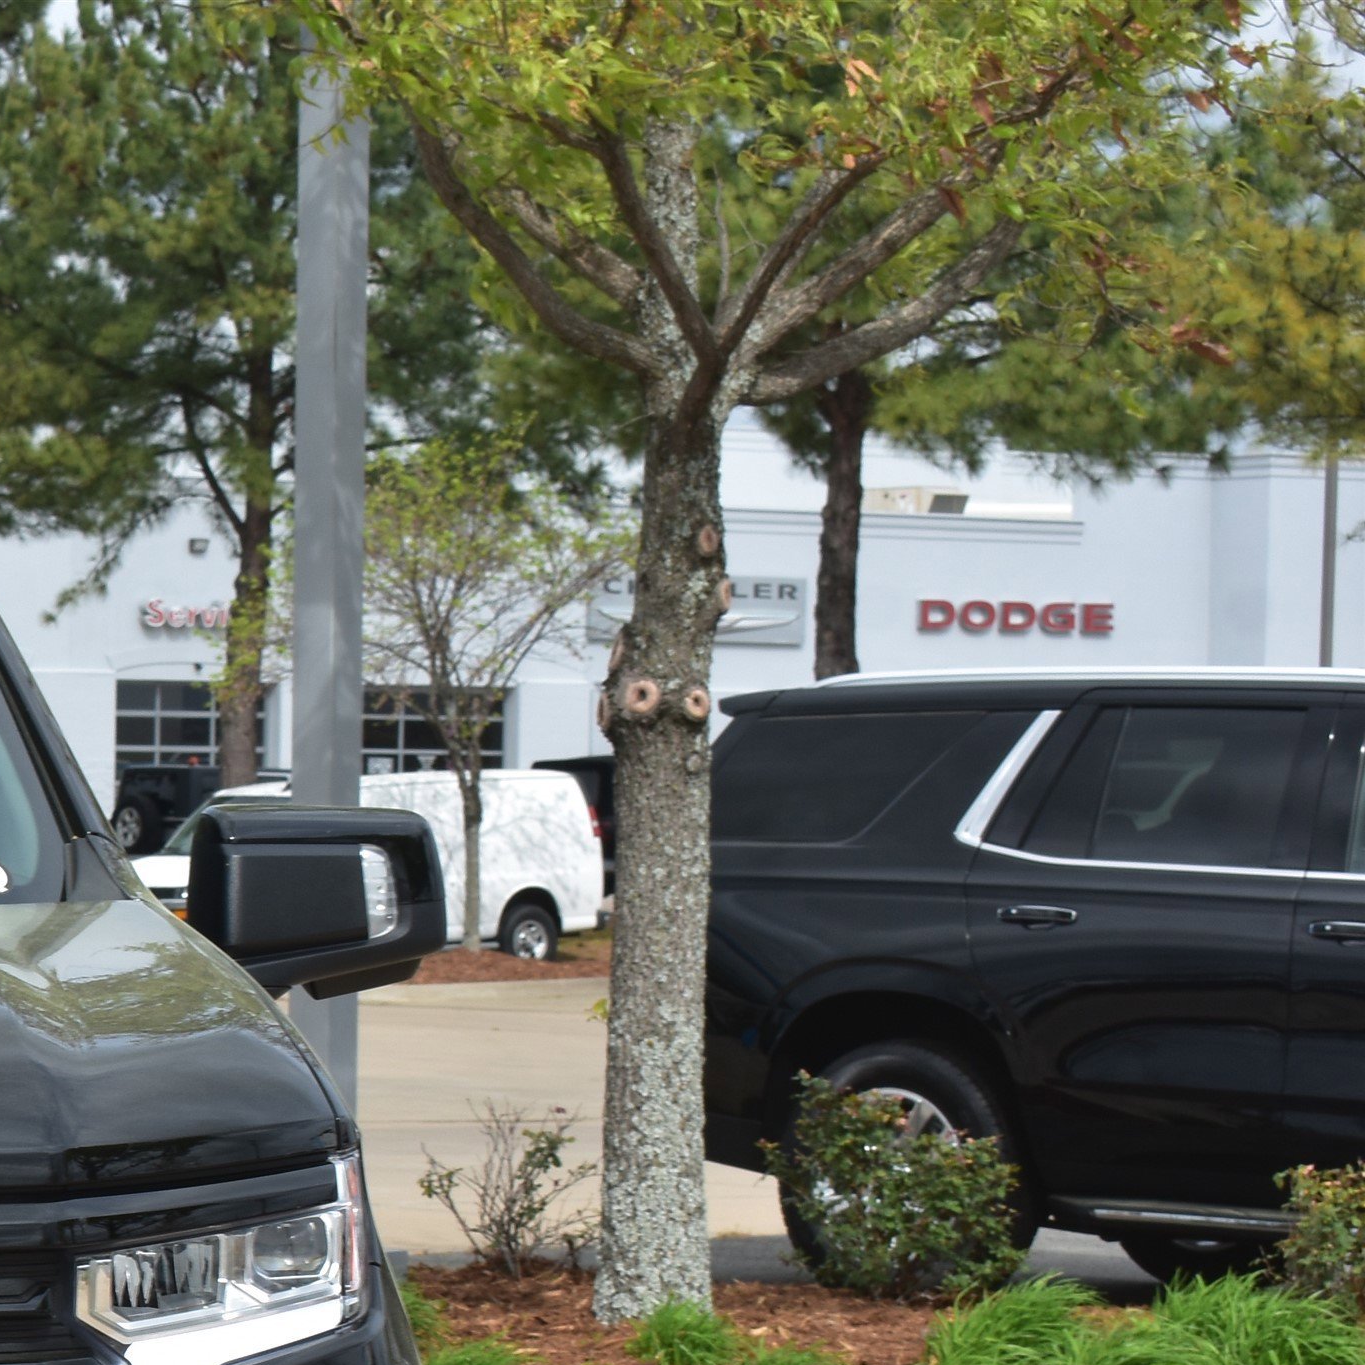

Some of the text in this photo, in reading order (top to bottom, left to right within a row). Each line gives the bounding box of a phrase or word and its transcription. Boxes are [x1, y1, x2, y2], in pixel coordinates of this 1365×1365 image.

[604, 577, 798, 600] CLER
[143, 598, 229, 629] Servi
[919, 599, 1115, 634] DODGE
